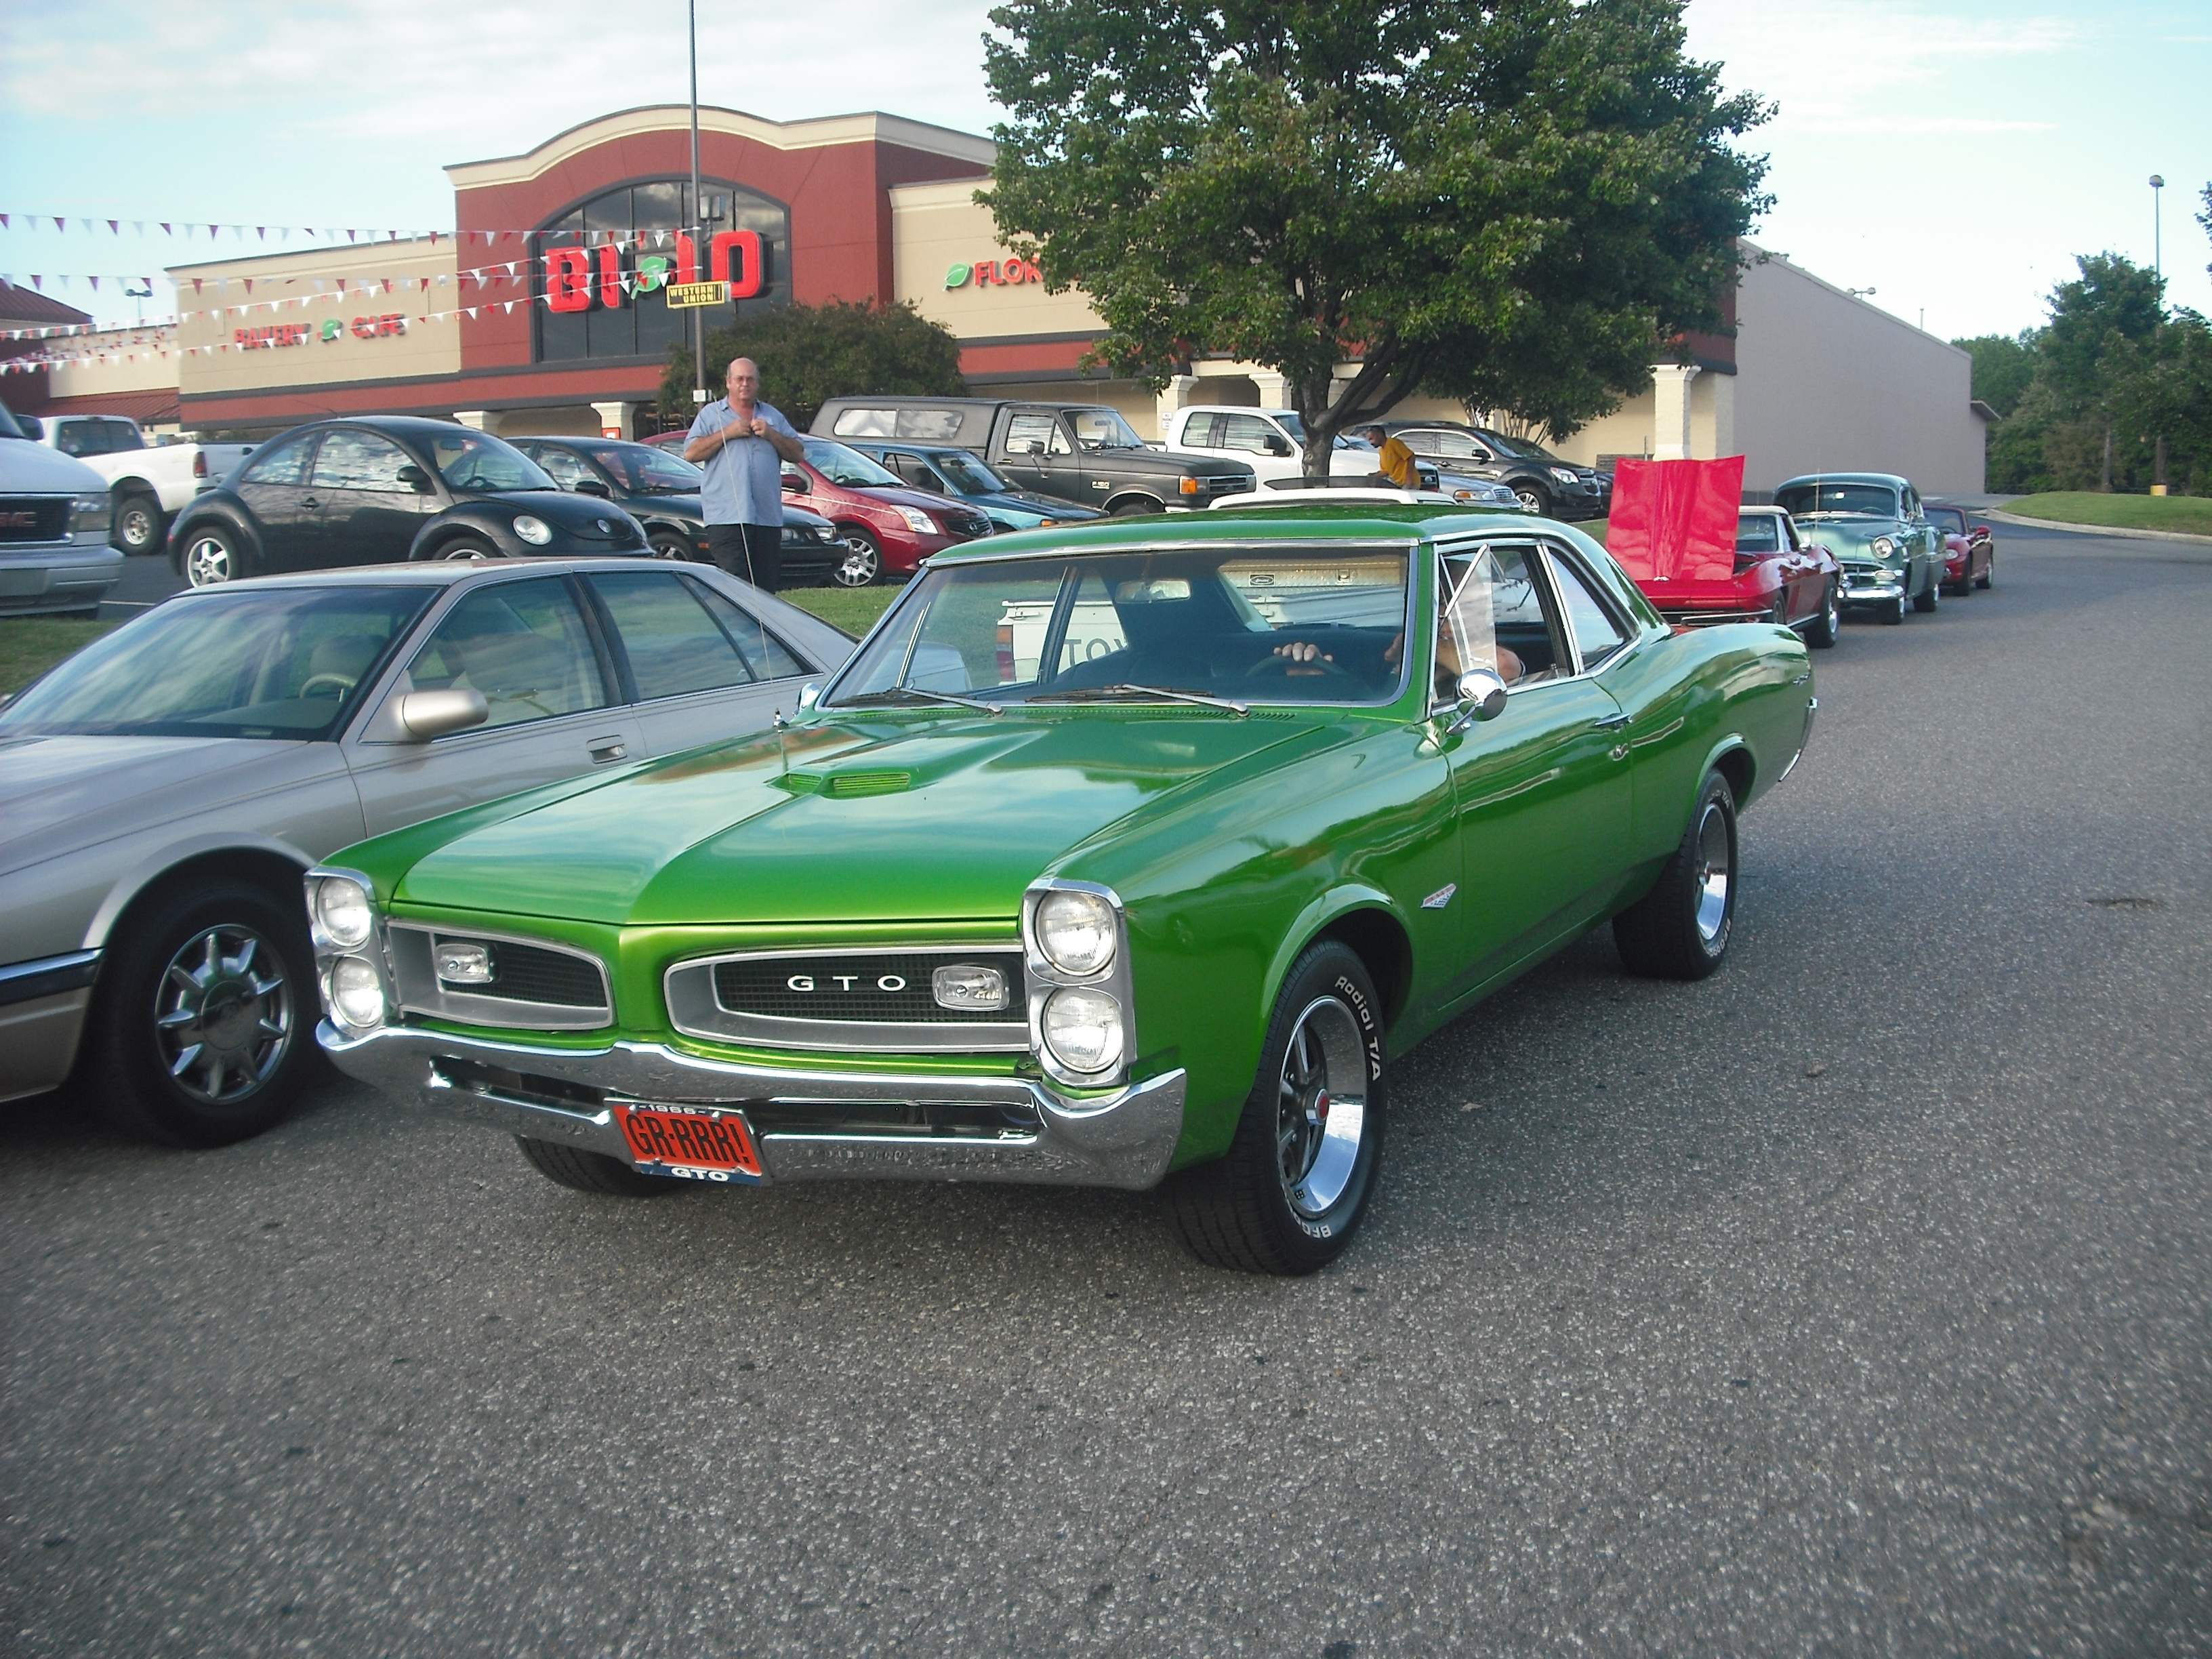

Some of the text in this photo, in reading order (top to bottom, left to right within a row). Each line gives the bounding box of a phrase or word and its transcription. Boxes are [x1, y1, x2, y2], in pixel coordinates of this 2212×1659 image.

[974, 256, 1044, 287] FLOR
[670, 285, 713, 297] WESTERN
[683, 293, 714, 303] UNION
[233, 314, 404, 350] BAKERY CAFE
[787, 975, 907, 991] GTO
[1334, 975, 1381, 1081] Radial T/A
[671, 1167, 729, 1183] GTO
